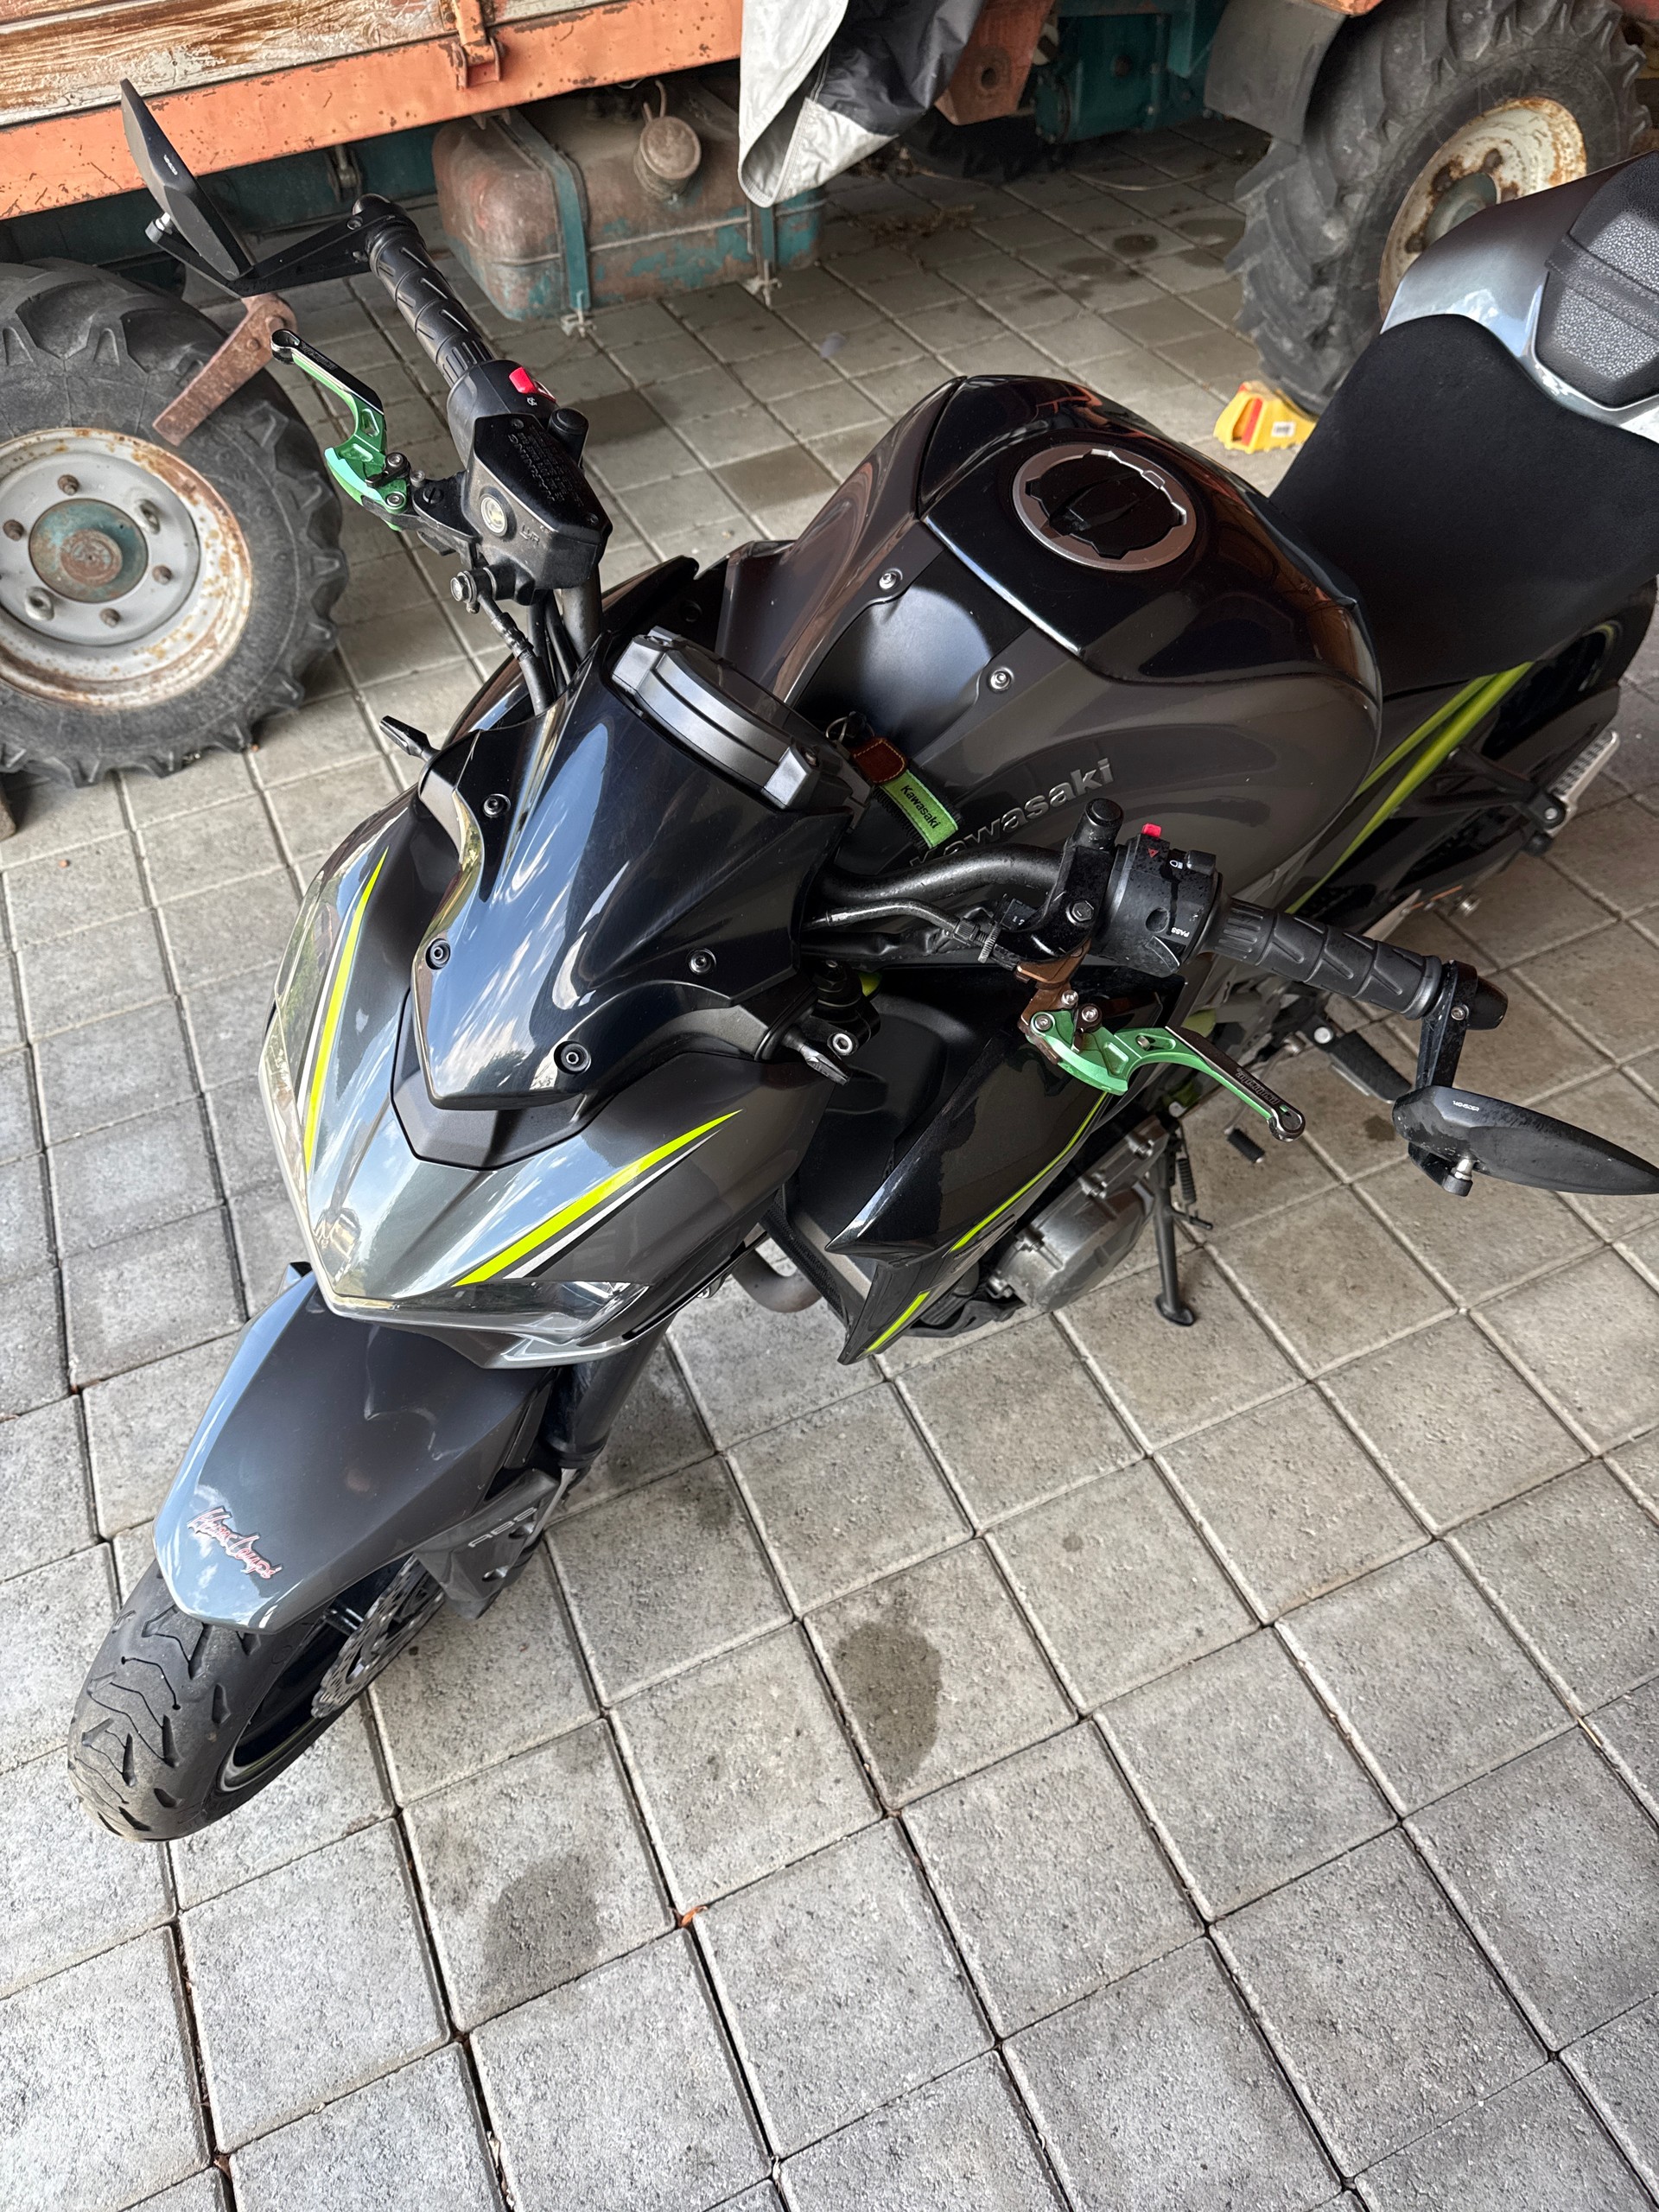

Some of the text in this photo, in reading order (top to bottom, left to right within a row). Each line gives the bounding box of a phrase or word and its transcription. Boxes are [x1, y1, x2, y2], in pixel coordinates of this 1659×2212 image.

[900, 785, 943, 830] Kawasaki
[1171, 927, 1190, 938] PASS
[467, 1507, 537, 1548] ABS
